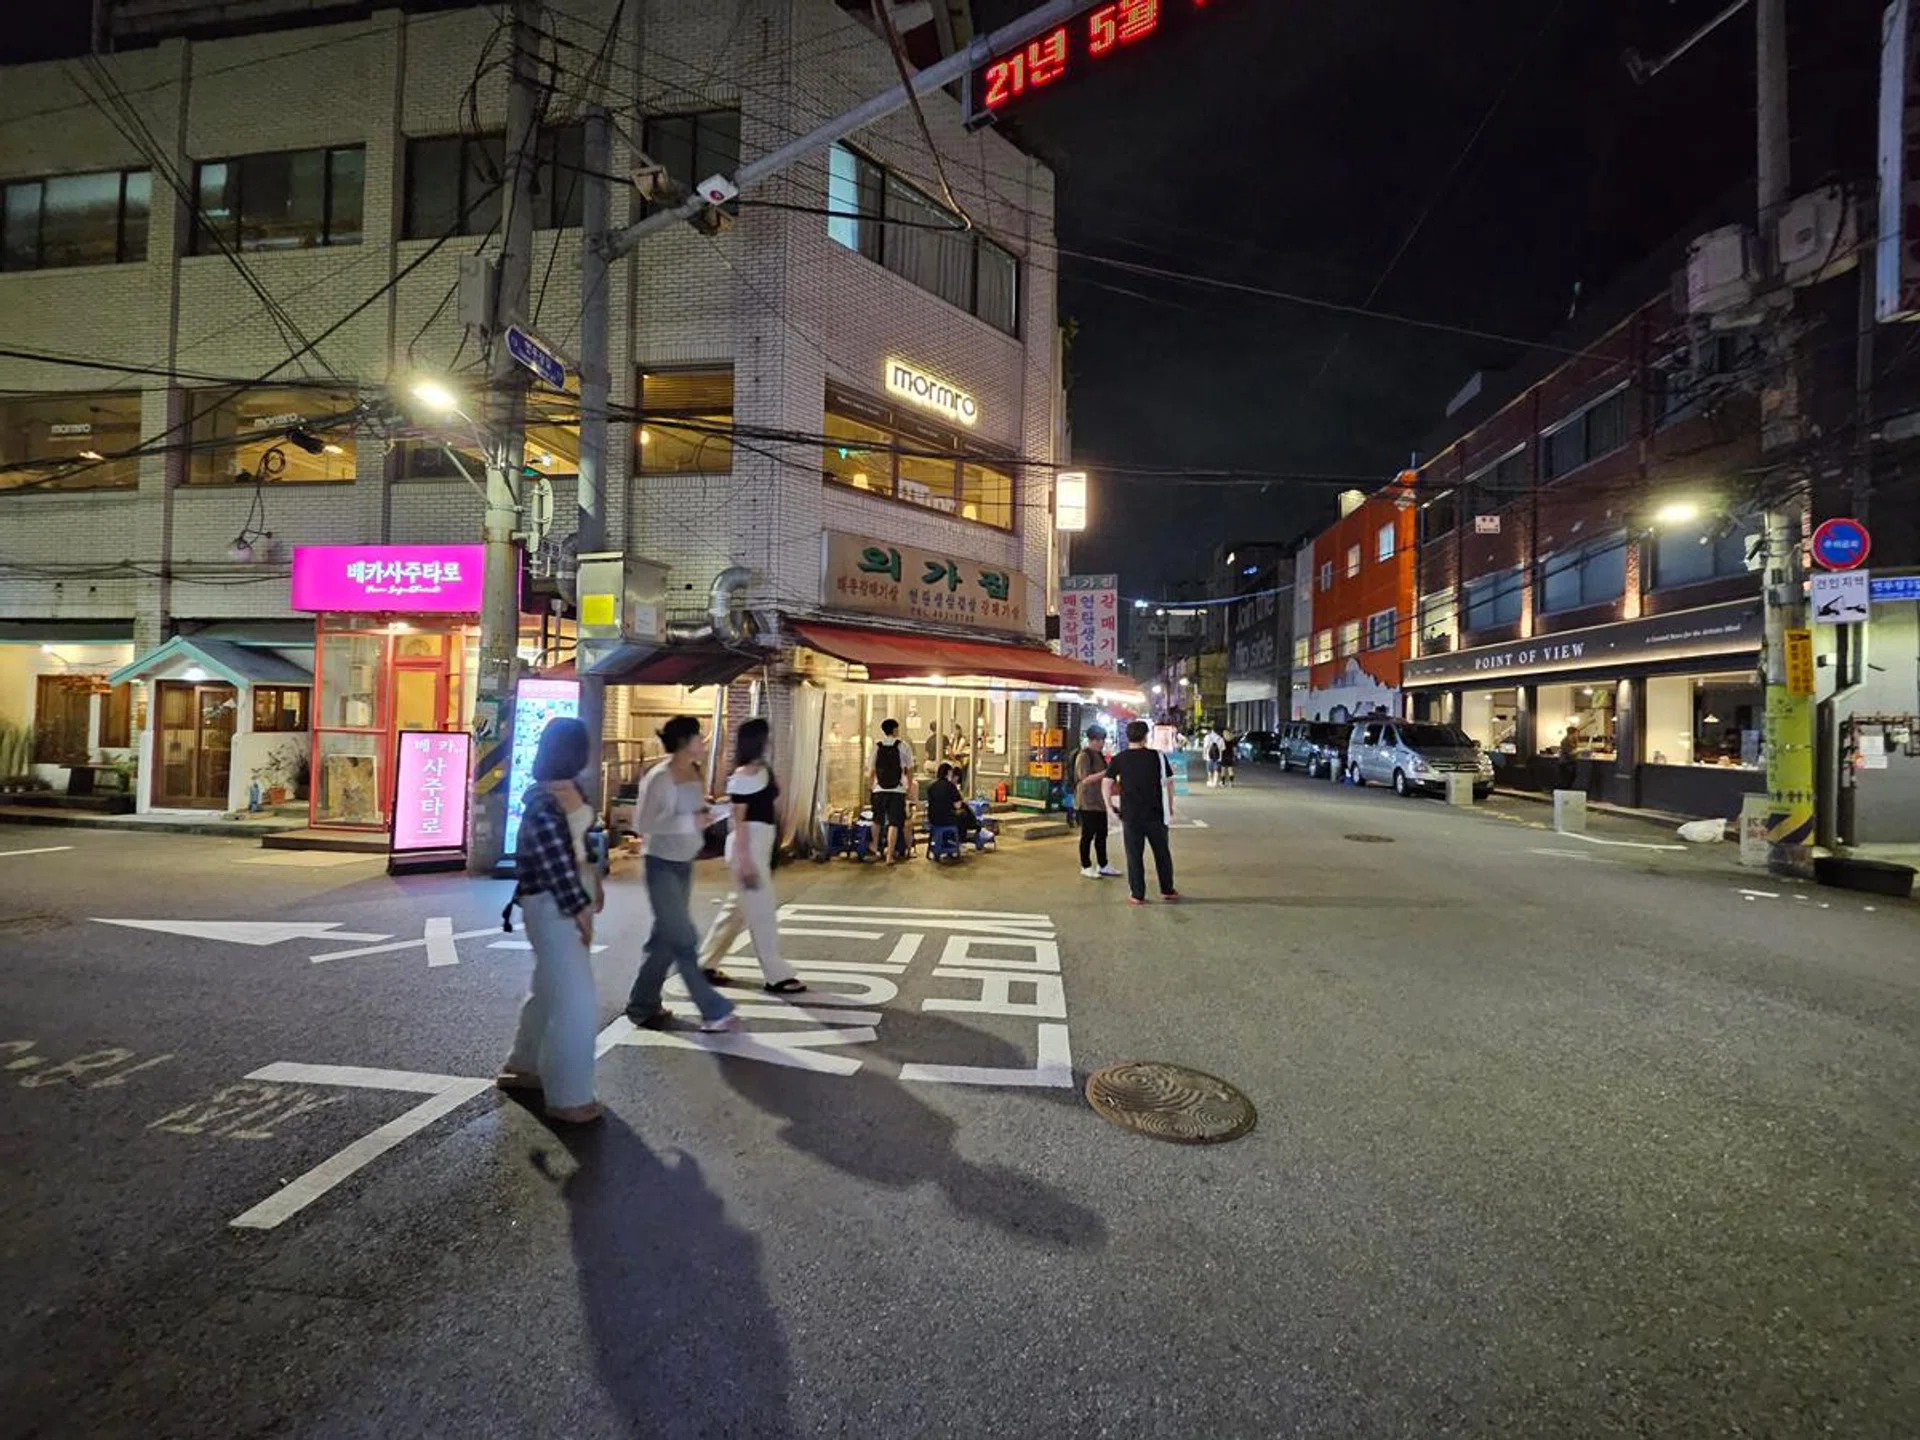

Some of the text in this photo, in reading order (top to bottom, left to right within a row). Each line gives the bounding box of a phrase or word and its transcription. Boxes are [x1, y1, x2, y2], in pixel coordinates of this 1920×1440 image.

[986, 0, 1158, 107] 21년 5월
[893, 366, 976, 417] mormro
[1816, 575, 1865, 591] 견인지역
[1474, 642, 1585, 671] POINT OF VIEW
[418, 756, 447, 834] 사주타로
